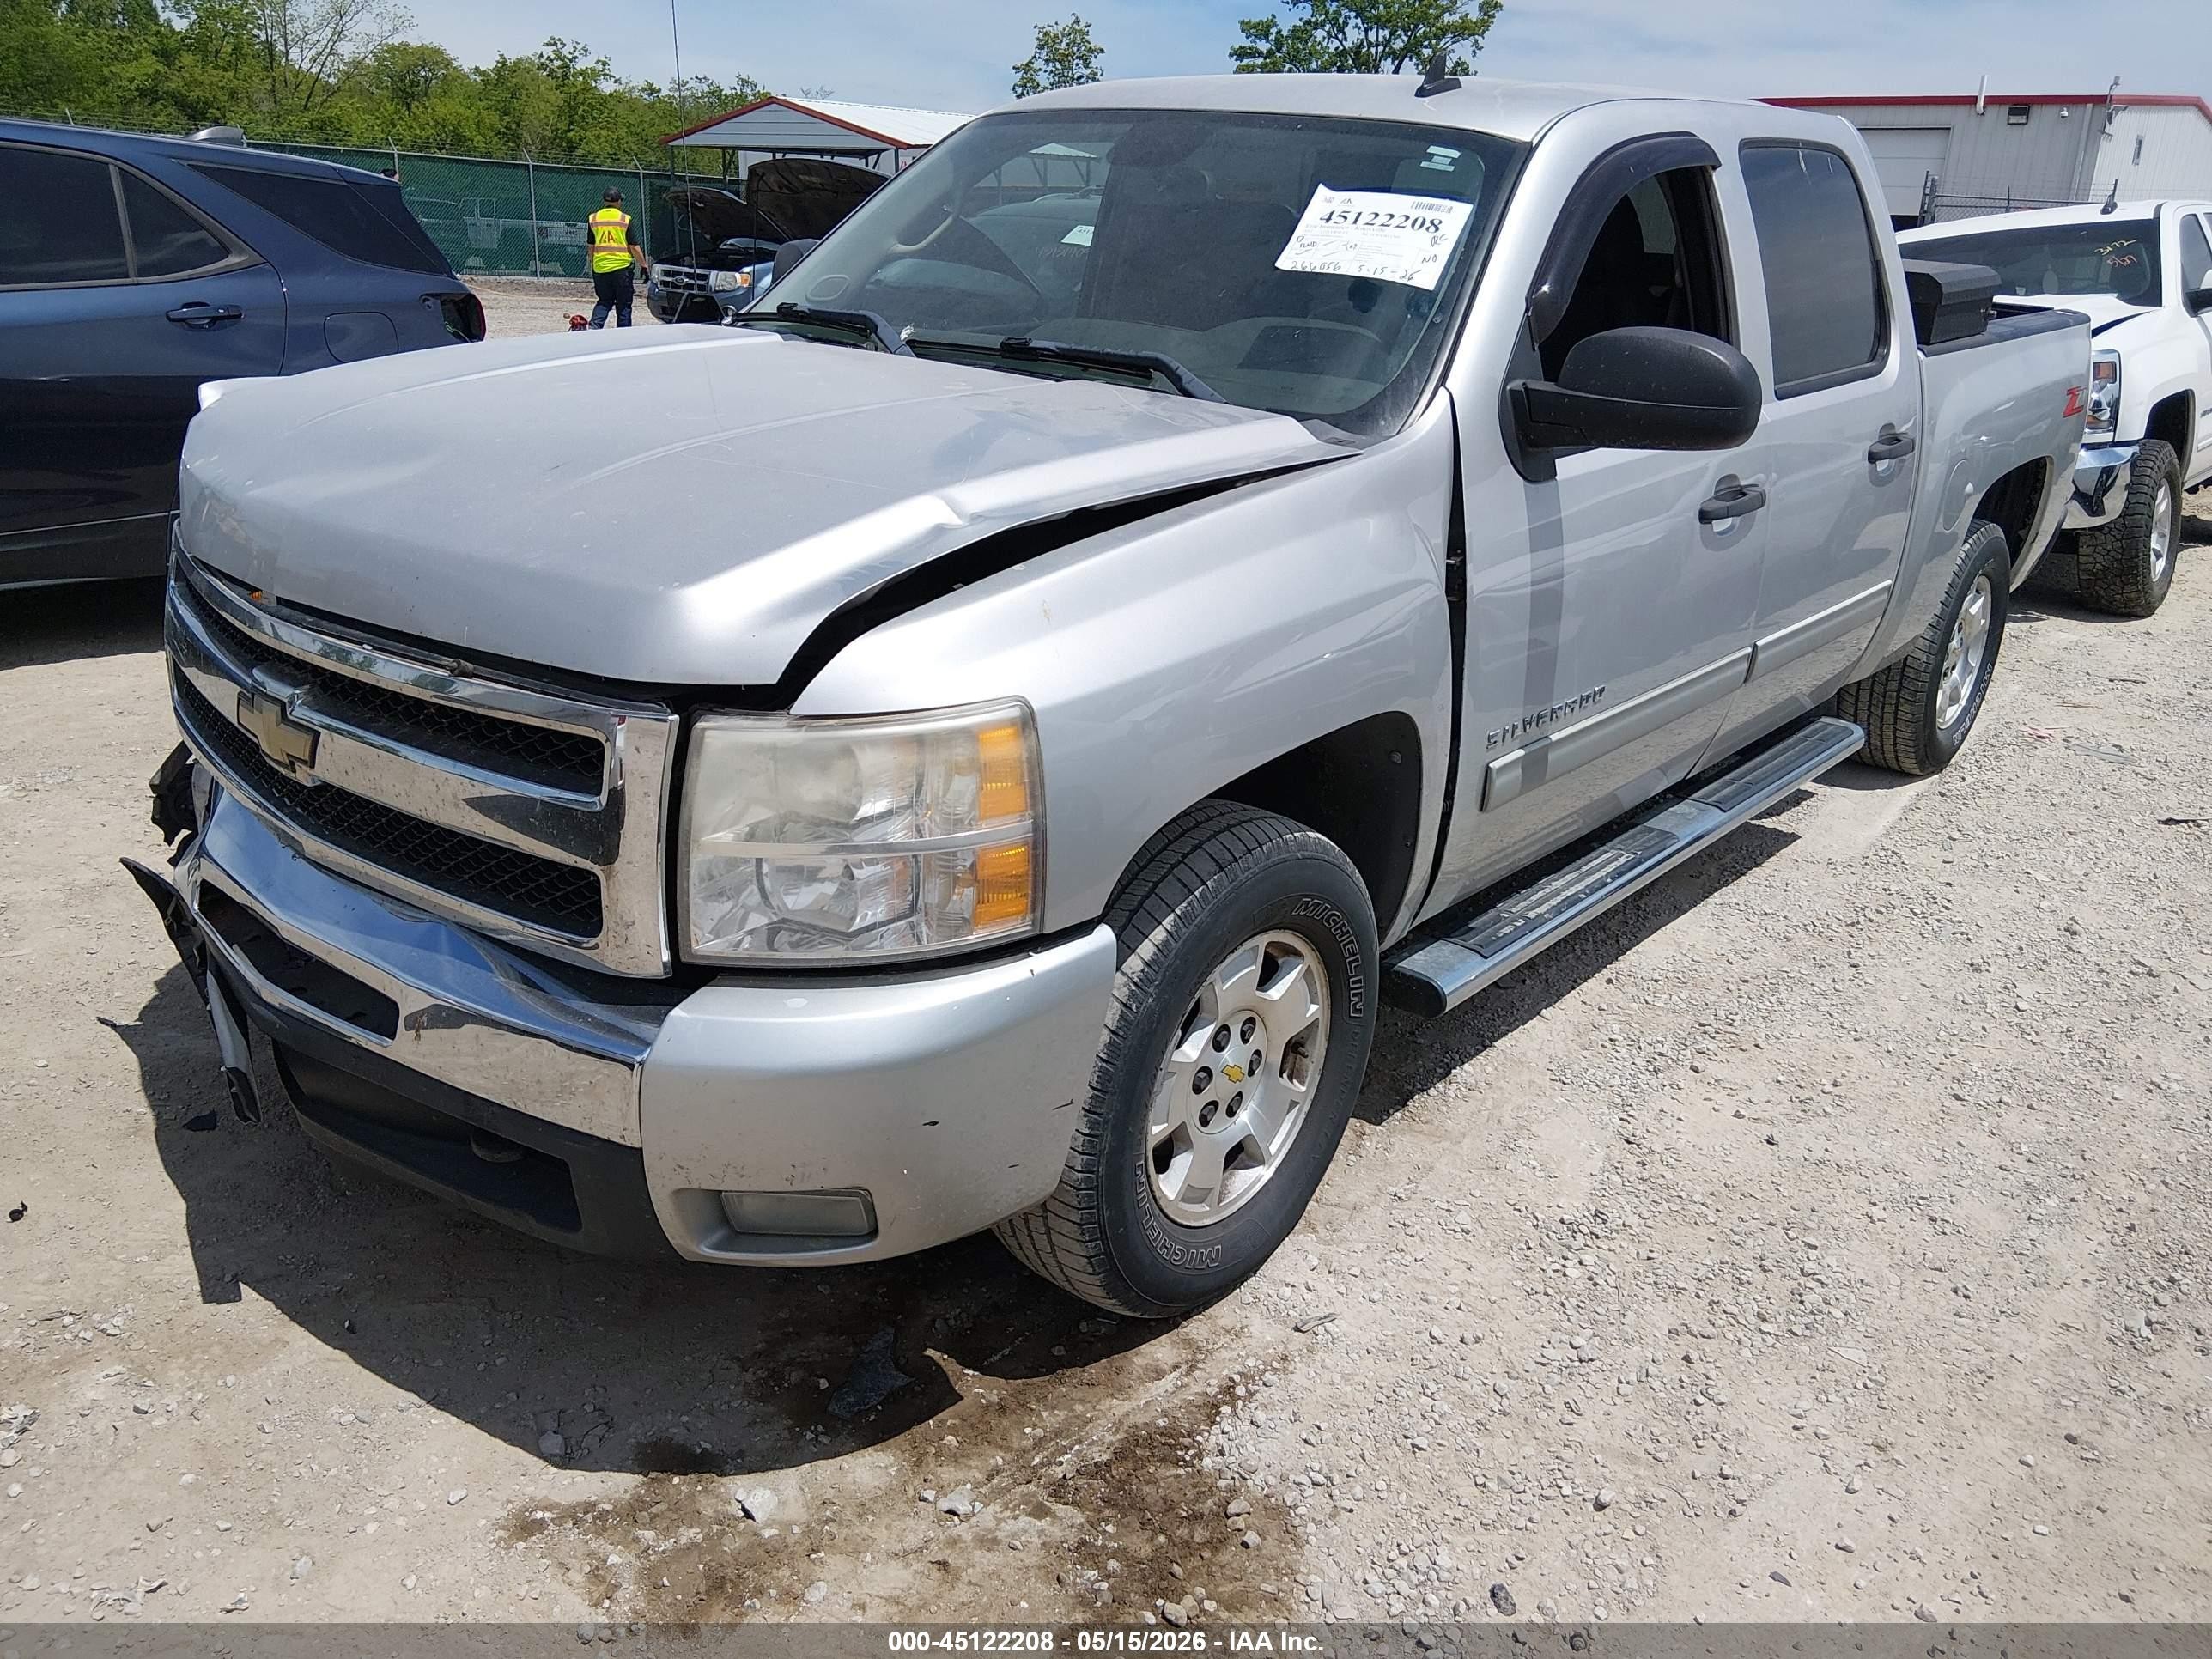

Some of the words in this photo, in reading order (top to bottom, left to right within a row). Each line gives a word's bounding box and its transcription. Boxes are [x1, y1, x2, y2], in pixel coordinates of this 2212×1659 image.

[1319, 210, 1443, 234] 45122208
[1486, 684, 1607, 750] SILVERADO
[1291, 897, 1364, 1018] MICHELIN
[1134, 1161, 1222, 1269] MICHELIN
